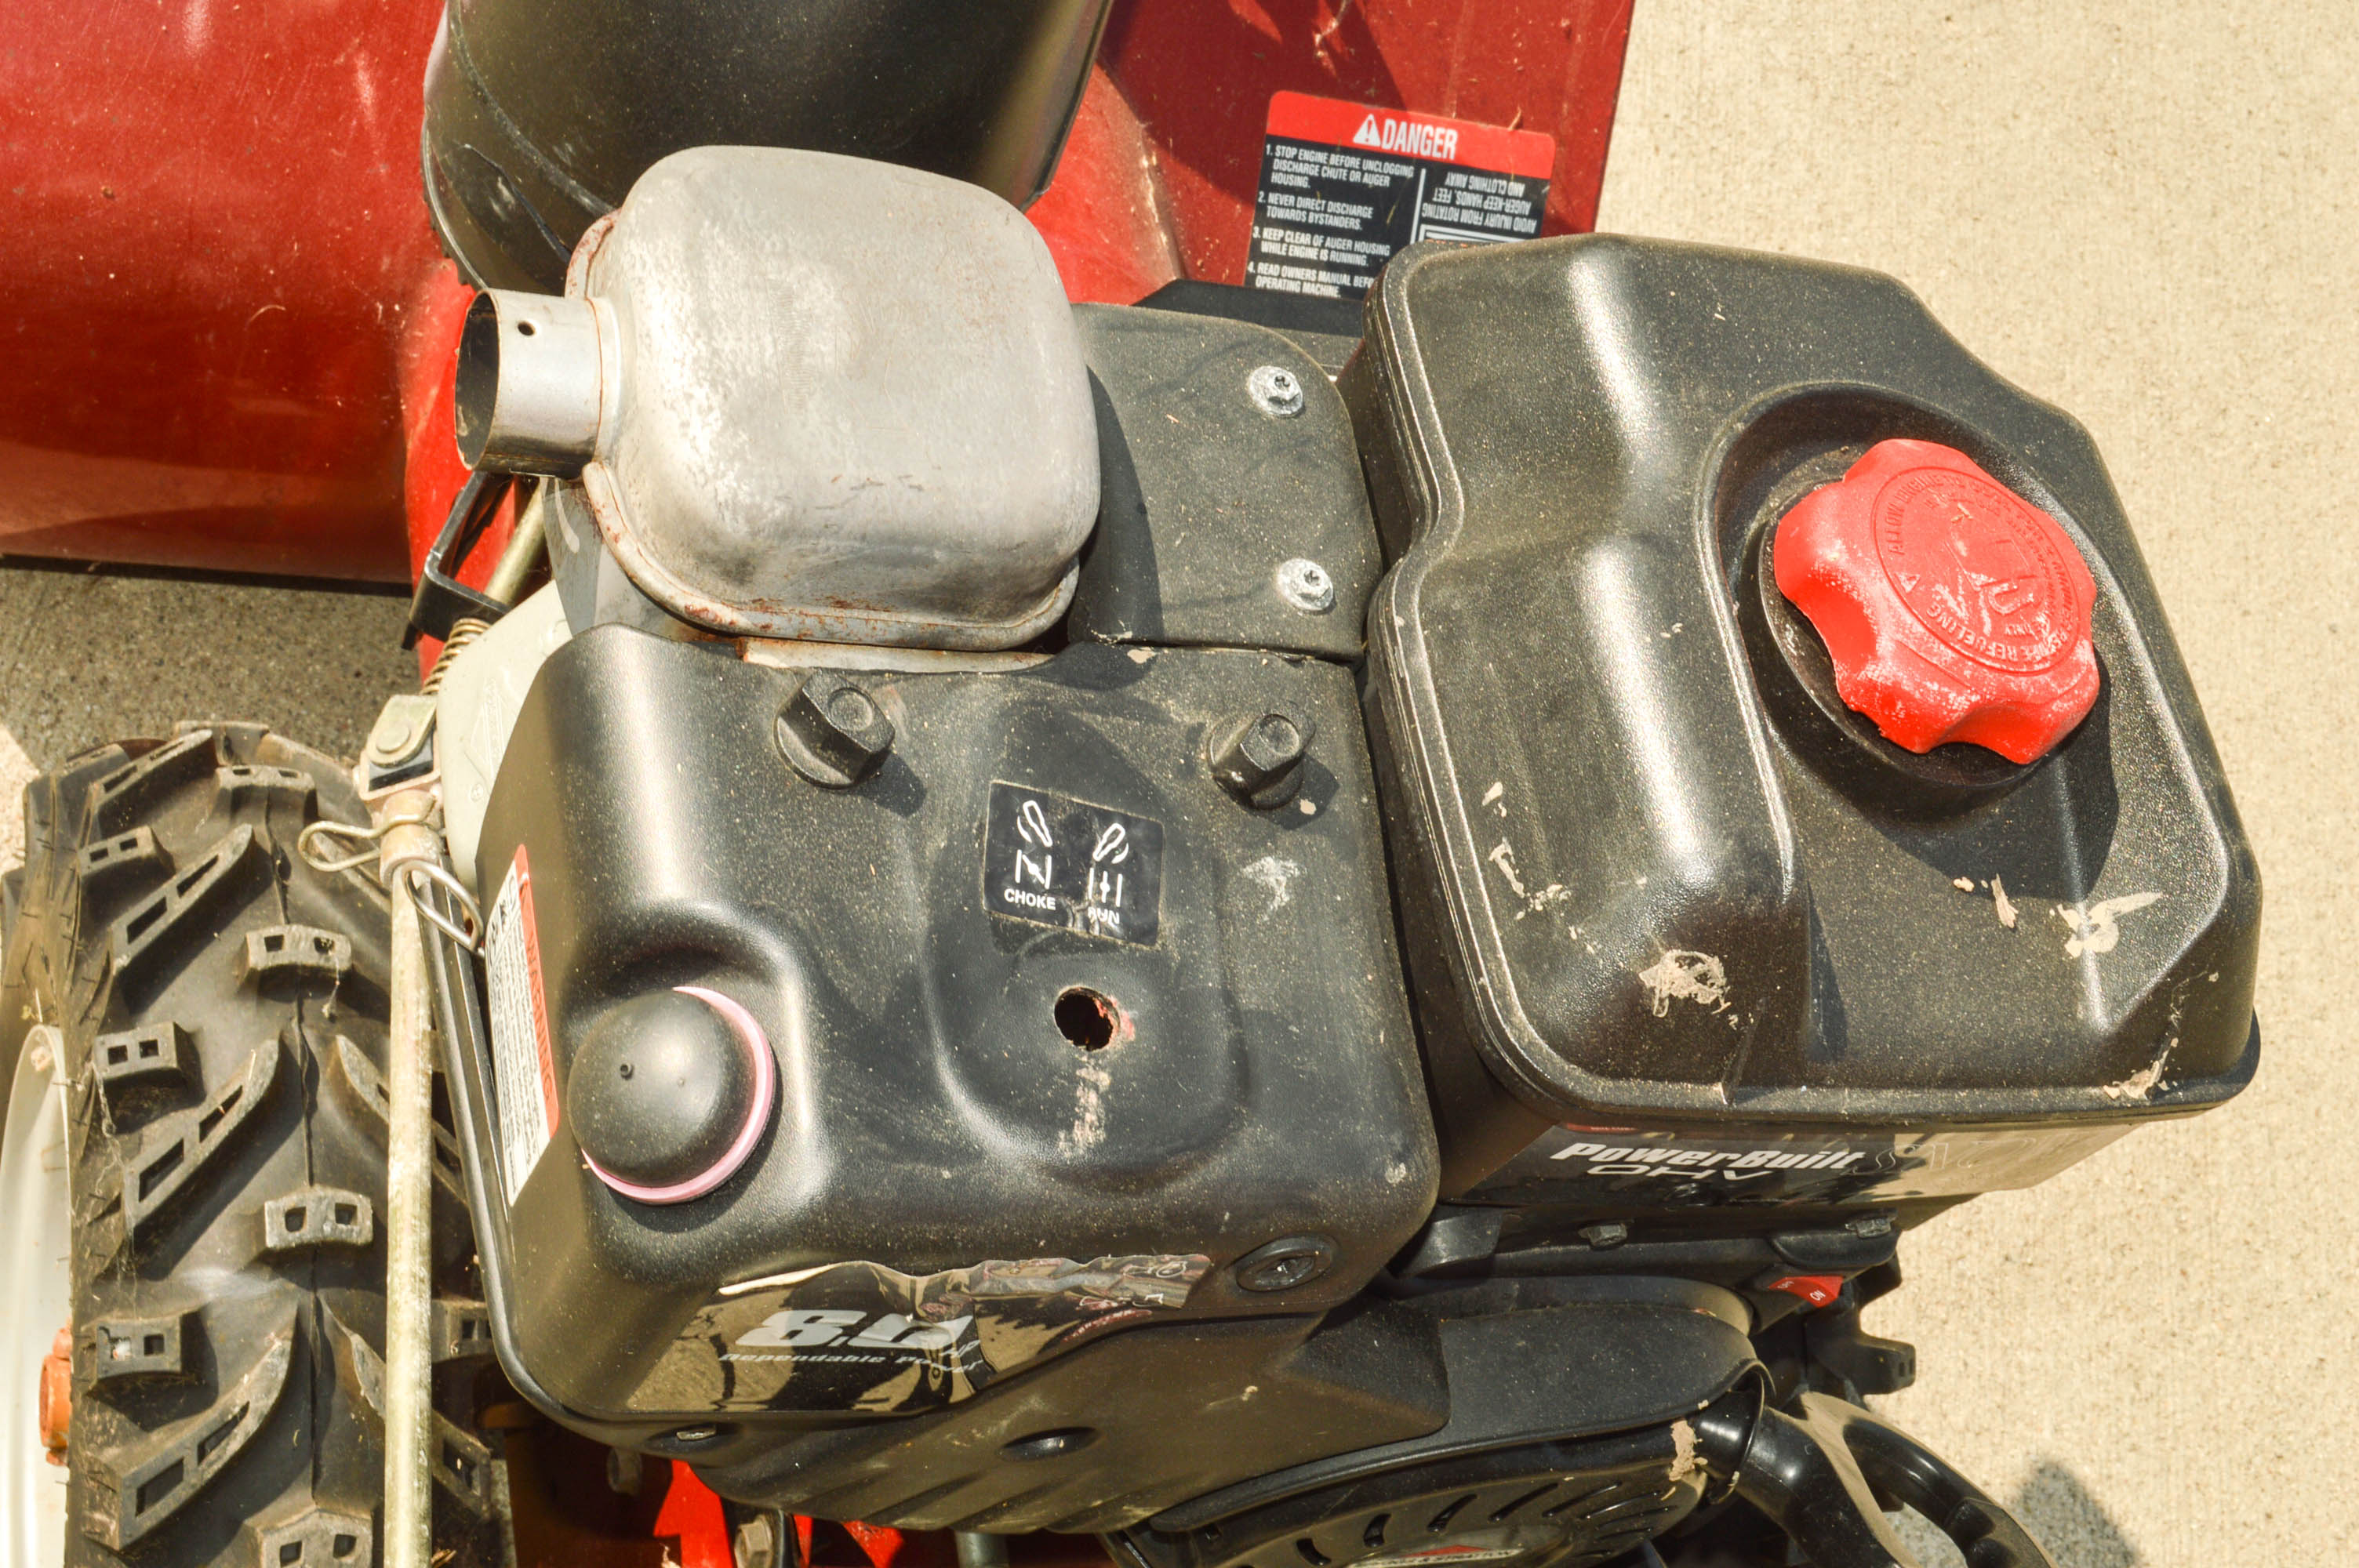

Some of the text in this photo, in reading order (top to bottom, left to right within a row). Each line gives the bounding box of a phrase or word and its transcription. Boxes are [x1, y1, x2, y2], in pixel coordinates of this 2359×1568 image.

[1381, 118, 1458, 160] DANGER
[1266, 144, 1414, 177] 1. STOP ENGINE BEFORE UNCLOGGING
[1273, 159, 1390, 187] DISCHARGE CHUTE OR AUGER
[1271, 172, 1310, 188] HOUSING.
[1445, 172, 1525, 198] AND CLOTHING AWAY
[1259, 191, 1373, 219] 2. NEVER DIRECT DISCHARGE
[1432, 187, 1451, 203] FEET
[1484, 196, 1531, 216] AUGER-KEEP
[1267, 205, 1361, 230] TOWARDS BYSTANDERS.
[1422, 202, 1537, 234] AVOID INJURY FROM ROTATING
[1252, 227, 1390, 256] 3. KEEP CLEAR OF AUGER HOUSING
[1261, 241, 1369, 267] WHILE ENGINE IS RUNNING.
[1248, 261, 1373, 289] 4. READ OWNERS MANUAL BEFO
[1256, 275, 1341, 298] OPERATING MACHINE.
[1885, 501, 1906, 556] ALLOW
[1926, 603, 2019, 662] REFUELING
[1004, 889, 1120, 924] CHOKE RUN
[525, 933, 553, 1099] WARNING
[1550, 1142, 1866, 1169] PowerBuilt
[1587, 1164, 1774, 1181] OHV
[1809, 1290, 1826, 1301] ON
[718, 1353, 886, 1363] Dependable
